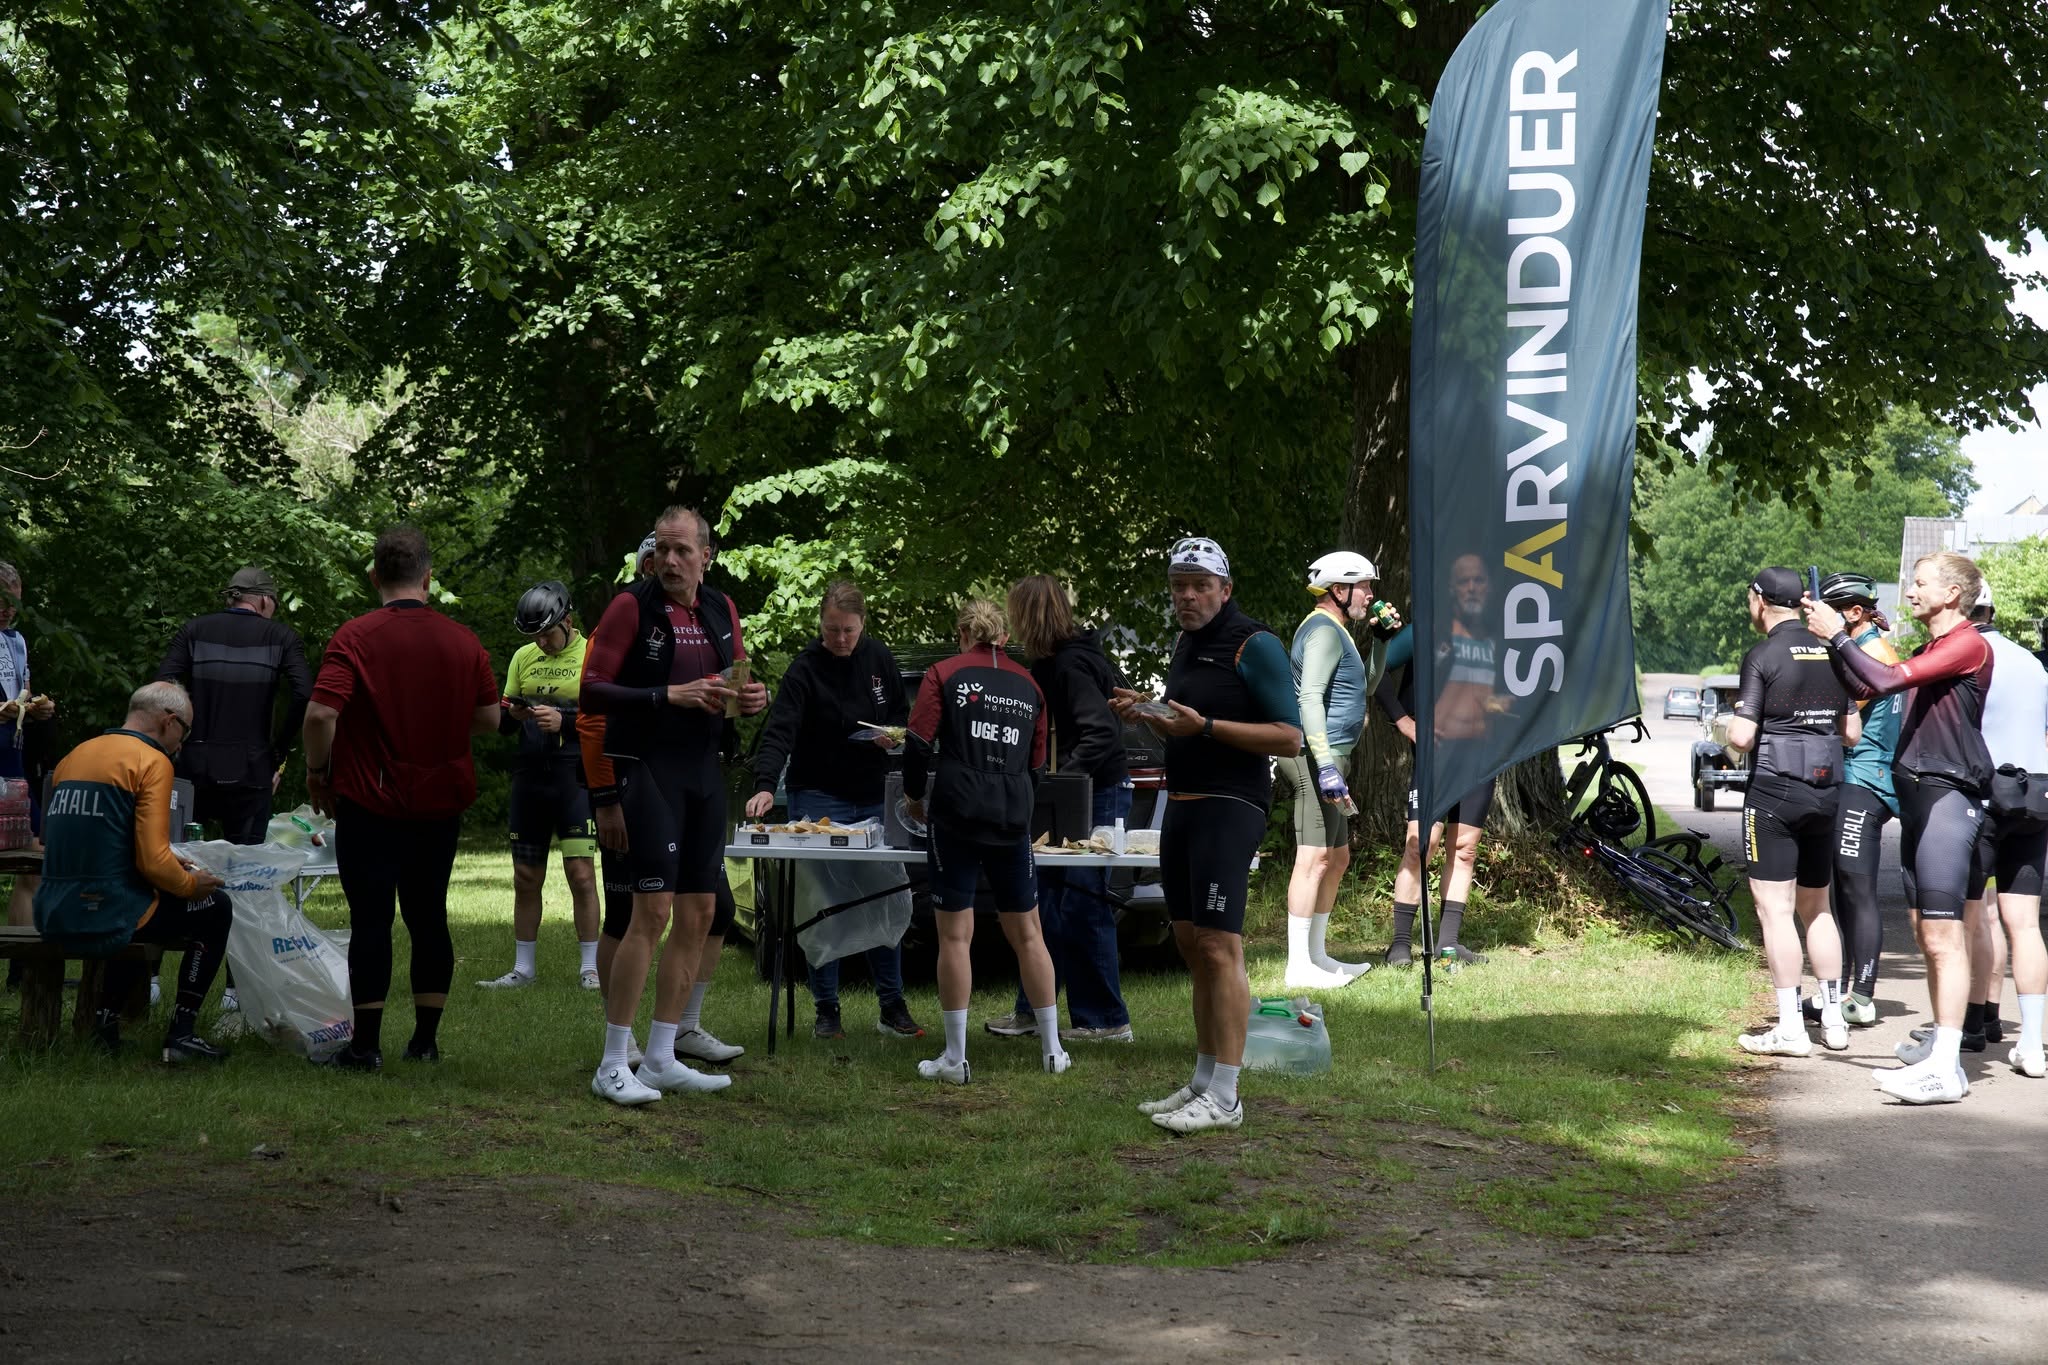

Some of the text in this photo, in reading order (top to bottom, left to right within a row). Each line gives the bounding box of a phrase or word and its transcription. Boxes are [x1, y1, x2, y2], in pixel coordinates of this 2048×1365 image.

[1504, 48, 1578, 697] SPARVINDUER
[530, 667, 576, 678] OCTAGON
[984, 694, 1033, 713] NORDFYNS
[984, 704, 1033, 720] HØJSKOLE
[971, 720, 1020, 746] UGE 30
[1840, 809, 1868, 858] BCHALL
[1206, 882, 1219, 910] WILLING
[1216, 895, 1227, 912] ABLE
